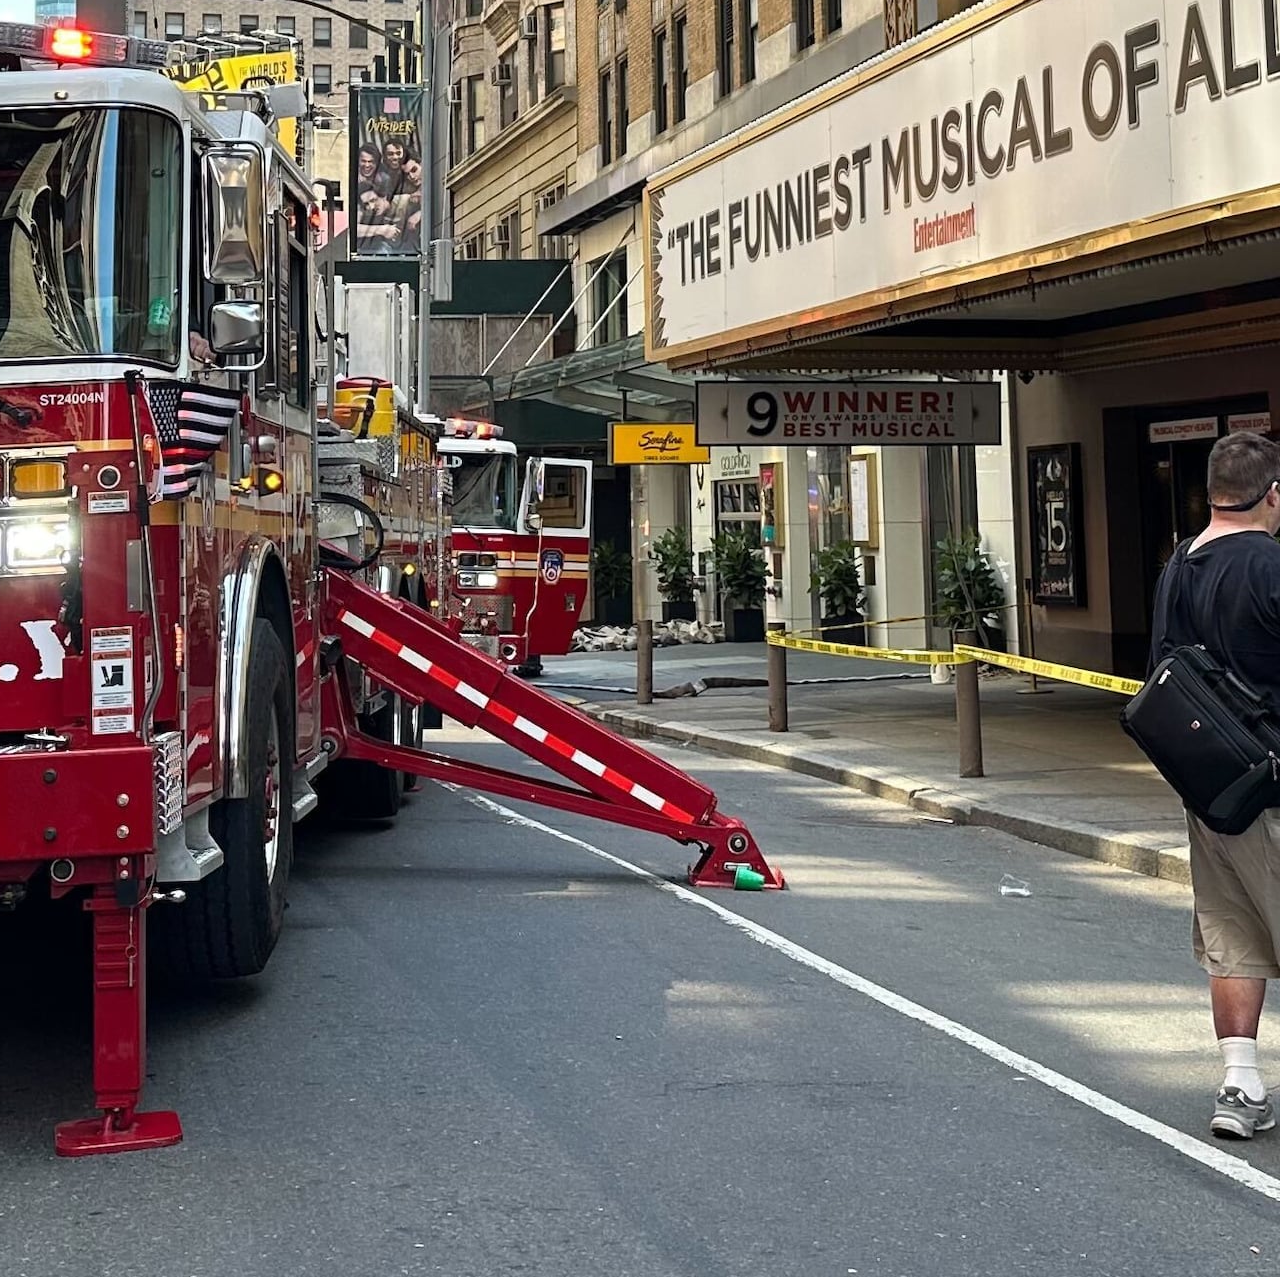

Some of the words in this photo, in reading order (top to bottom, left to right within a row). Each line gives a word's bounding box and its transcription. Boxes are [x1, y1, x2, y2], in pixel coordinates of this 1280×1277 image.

[727, 143, 872, 270] FUNNIEST
[882, 64, 1073, 215] MUSICAL
[1082, 19, 1160, 141] OF
[913, 204, 976, 254] Entertainment
[40, 392, 104, 406] ST24004N
[747, 392, 778, 436] 9
[783, 391, 954, 413] WINNER!
[886, 414, 955, 422] INCLUDING
[783, 423, 842, 437] BEST
[852, 423, 955, 437] MUSICAL
[1045, 502, 1067, 553] 15
